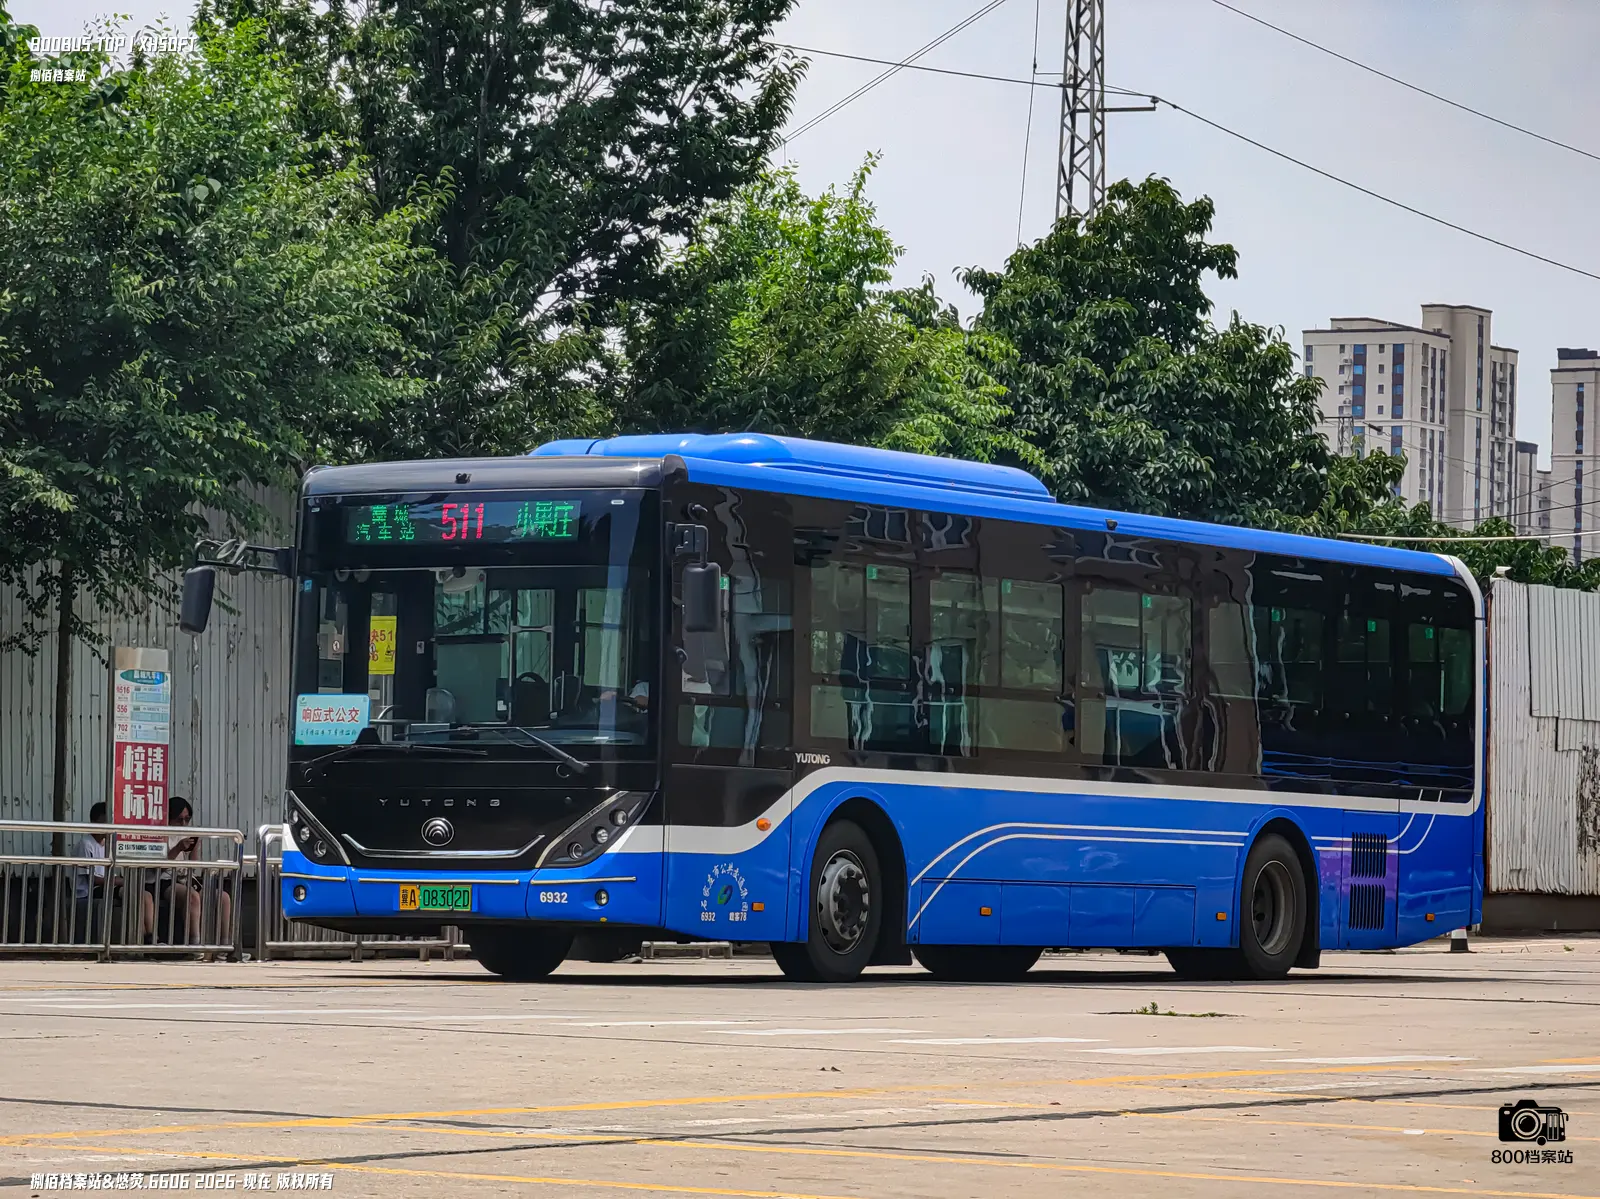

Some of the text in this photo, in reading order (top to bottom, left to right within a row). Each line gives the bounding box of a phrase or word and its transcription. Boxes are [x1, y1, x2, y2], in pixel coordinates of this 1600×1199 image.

[441, 503, 484, 540] 511
[116, 704, 128, 713] 556
[302, 707, 360, 723] 响应式公交
[118, 723, 129, 732] 702
[122, 745, 164, 782] 梓清
[794, 752, 831, 765] YUTONG
[122, 784, 164, 820] 标识
[378, 798, 501, 807] YUTONG
[540, 891, 568, 904] 6932
[700, 911, 716, 922] 6932
